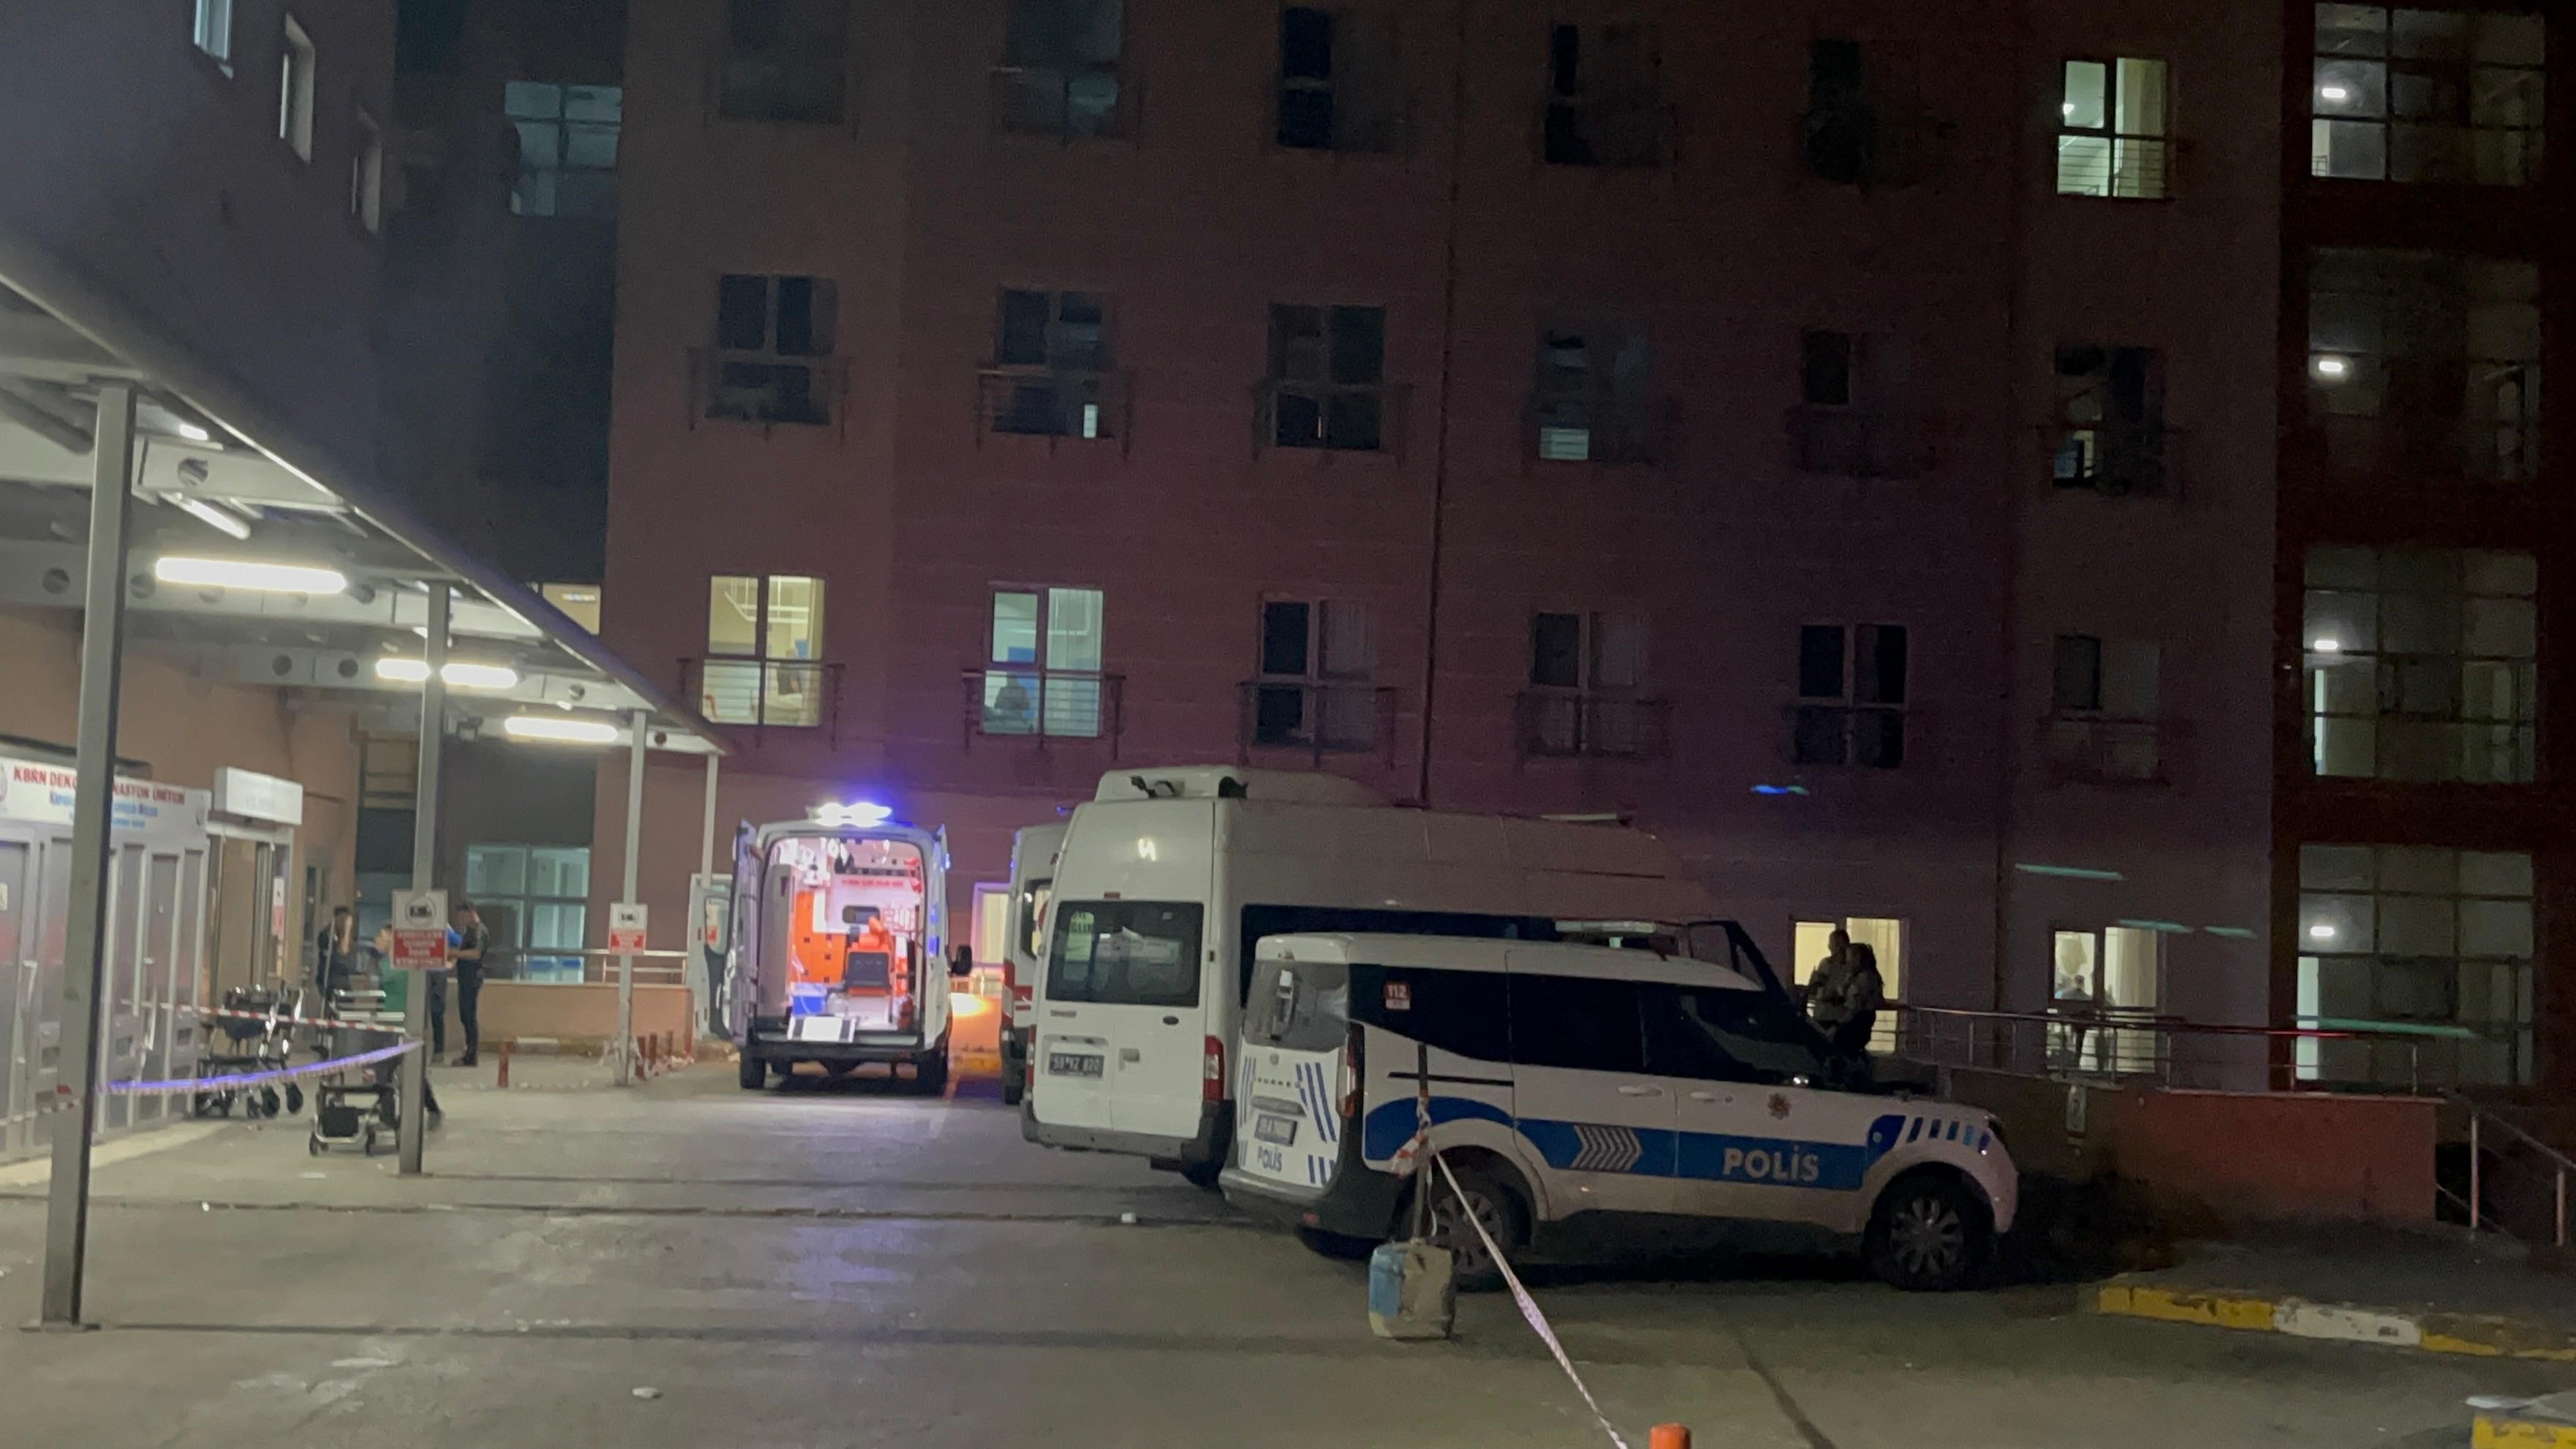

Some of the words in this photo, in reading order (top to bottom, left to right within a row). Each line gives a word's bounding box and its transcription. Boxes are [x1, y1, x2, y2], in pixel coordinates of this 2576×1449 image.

[14, 765, 47, 785] KBRN
[1388, 984, 1407, 998] 112
[1257, 1146, 1282, 1172] POLİS
[1723, 1144, 1820, 1182] POLİS
